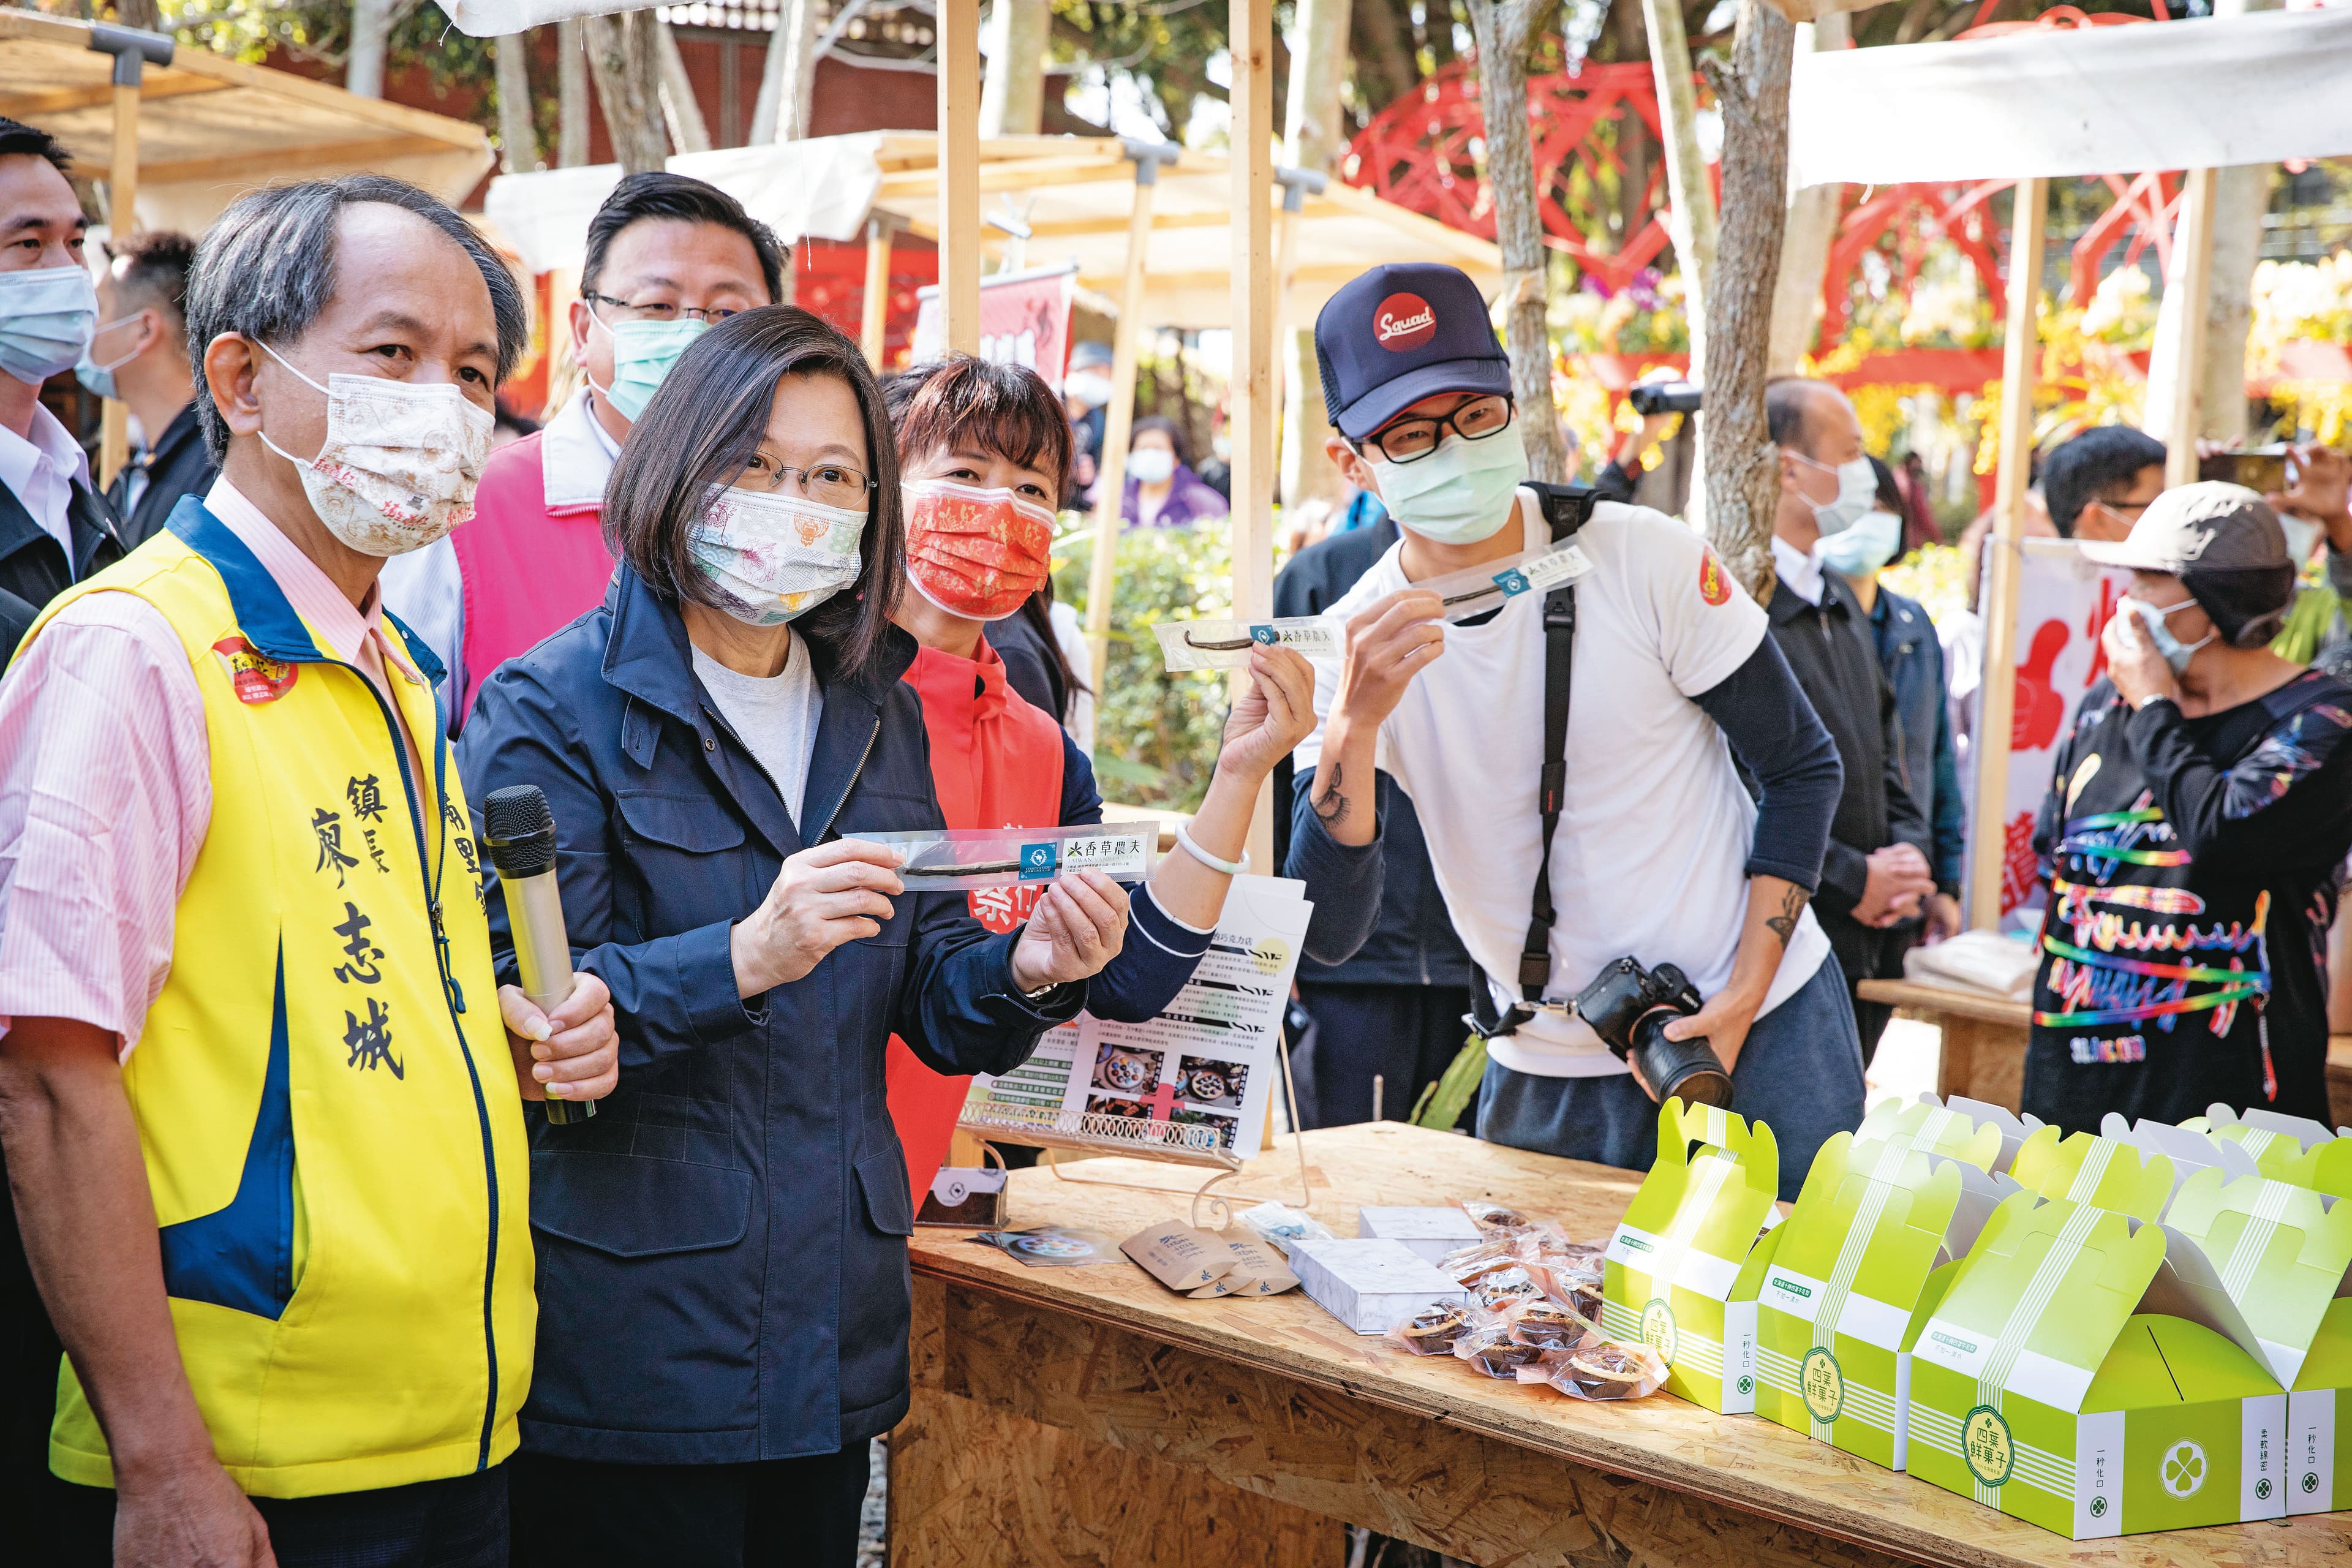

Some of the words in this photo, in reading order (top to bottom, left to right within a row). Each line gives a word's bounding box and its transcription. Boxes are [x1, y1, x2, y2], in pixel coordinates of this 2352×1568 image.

[1379, 307, 1434, 341] Squad
[347, 774, 390, 873] 鎮長
[1086, 839, 1140, 856] 香草農夫
[312, 808, 404, 1080] 廖志城
[1651, 1319, 1667, 1334] 四葉
[1743, 1334, 1751, 1367] 一秒化口
[1813, 1368, 1831, 1387] 四葉
[1807, 1381, 1838, 1406] 鮮菓子
[1977, 1427, 1999, 1449] 四葉
[2308, 1427, 2316, 1464] 一秒化口
[1970, 1441, 2007, 1468] 鮮菓子
[2097, 1449, 2105, 1488] 一秒化口
